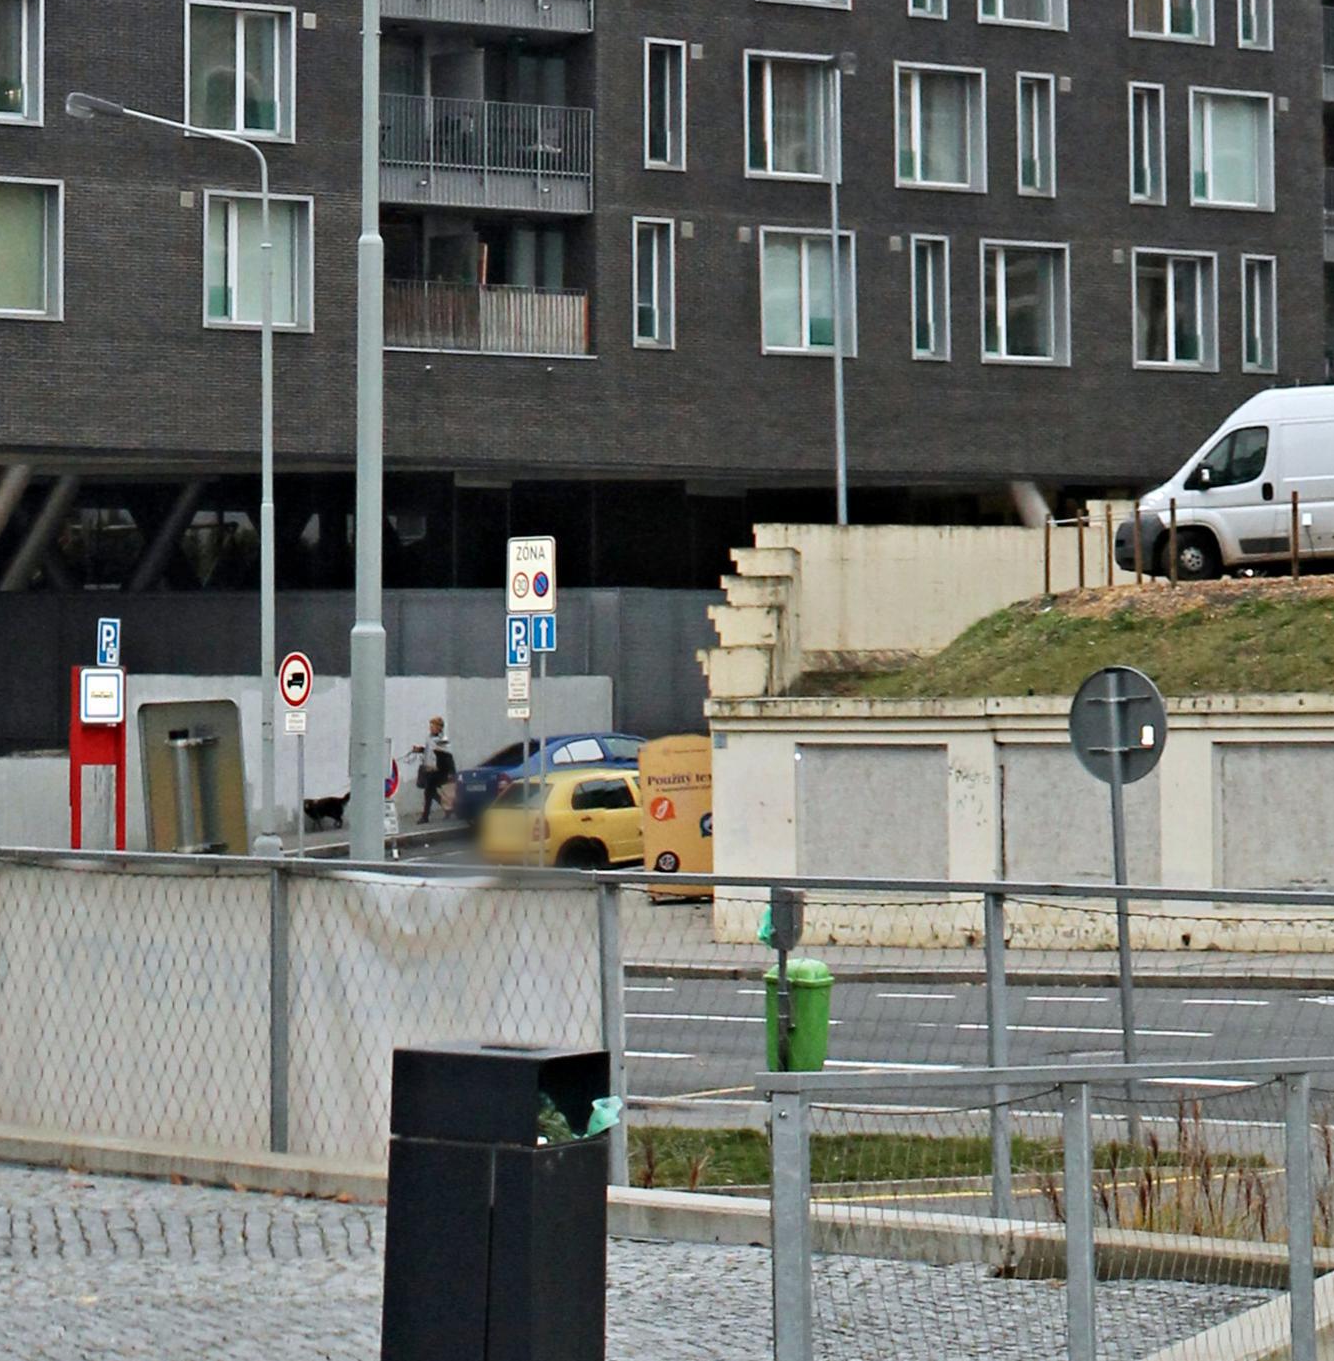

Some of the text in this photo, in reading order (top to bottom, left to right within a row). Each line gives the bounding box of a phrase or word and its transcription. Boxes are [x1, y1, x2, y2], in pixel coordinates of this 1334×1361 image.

[516, 541, 546, 561] ZÓNA
[102, 624, 116, 651] P
[511, 620, 526, 651] P
[647, 772, 691, 787] Použitý
